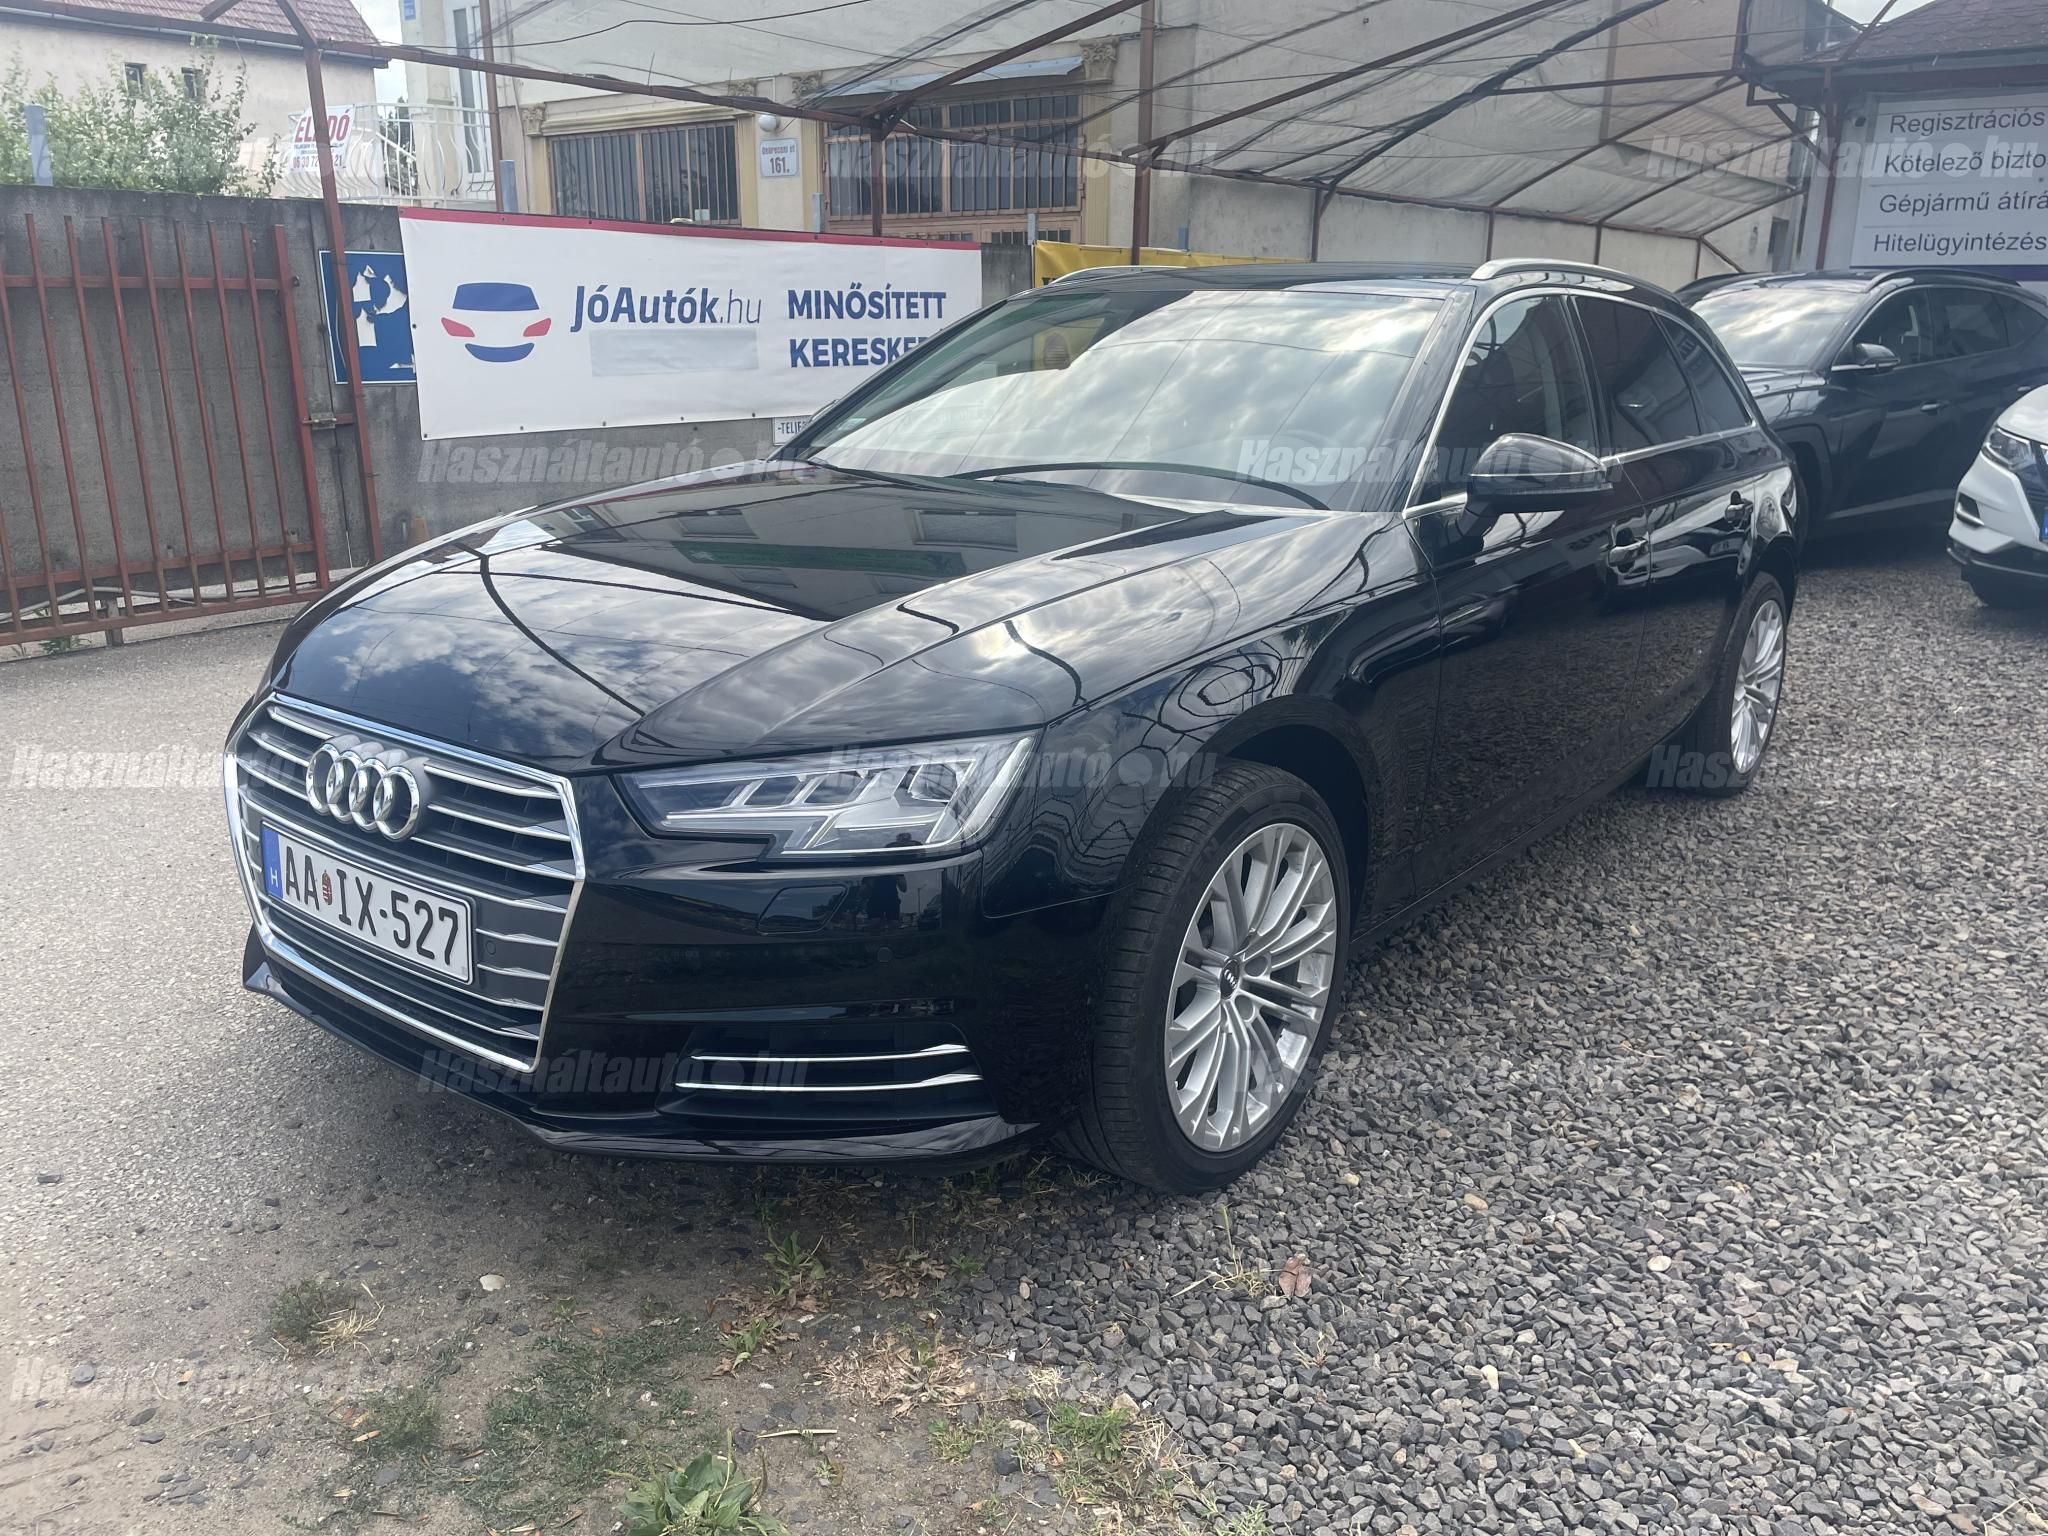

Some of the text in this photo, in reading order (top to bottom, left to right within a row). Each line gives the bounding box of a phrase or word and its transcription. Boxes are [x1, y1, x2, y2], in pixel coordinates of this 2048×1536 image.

[294, 109, 350, 143] ELDÓ
[1889, 107, 2046, 136] Regisztrációs
[770, 156, 790, 174] 161.
[1884, 152, 1983, 173] Kötelező
[1879, 192, 1990, 216] Gépjármű
[1873, 232, 2048, 256] Hitelügyintézés
[570, 284, 762, 332] JóAutók.hu
[788, 281, 947, 320] MINŐSÍTETT
